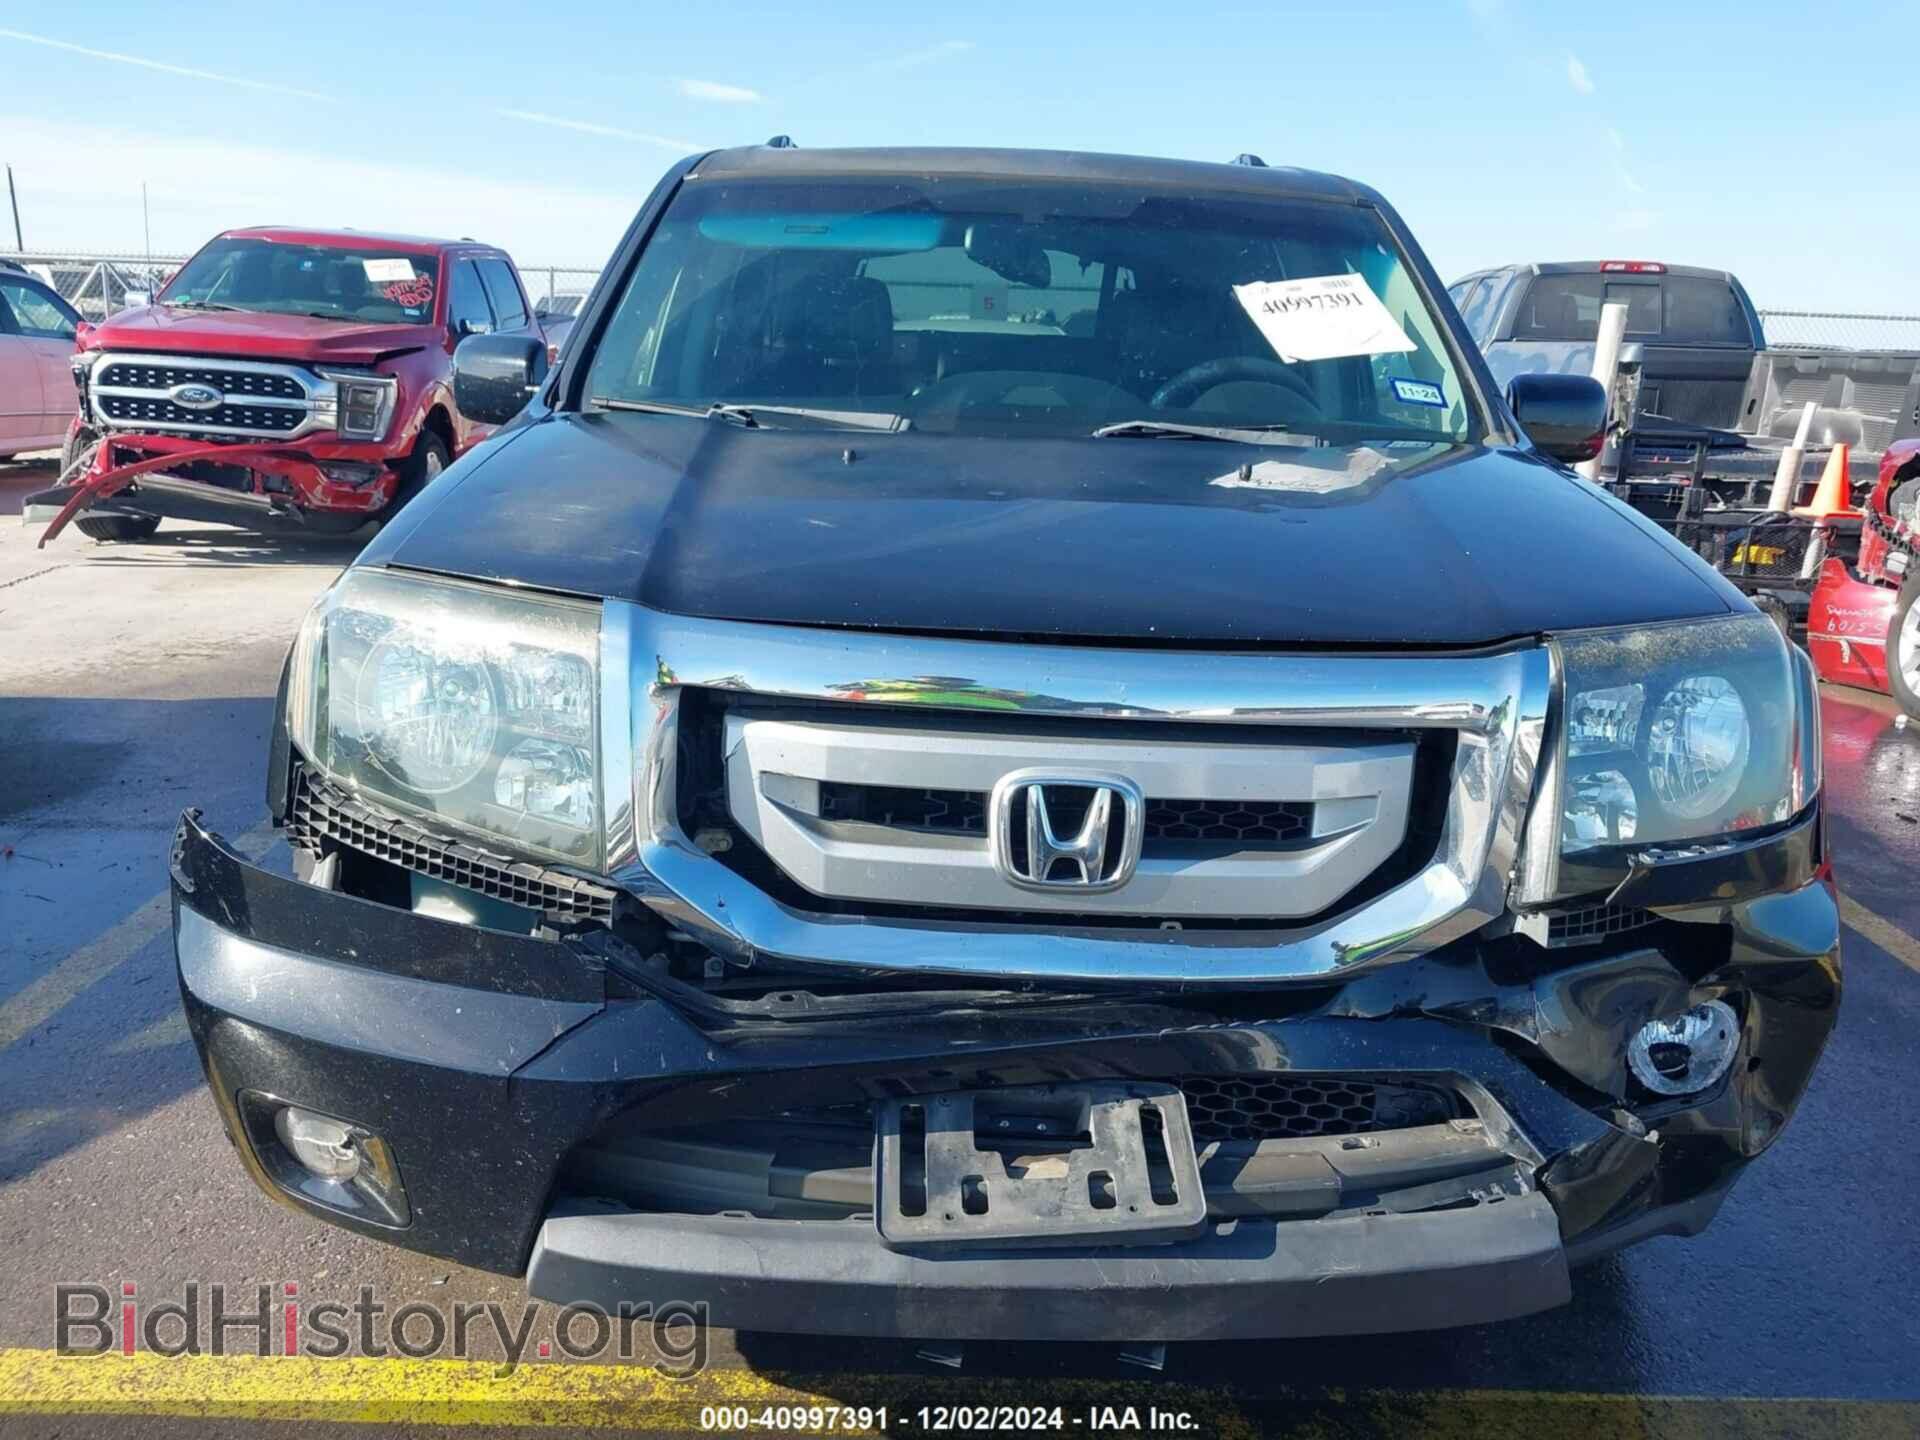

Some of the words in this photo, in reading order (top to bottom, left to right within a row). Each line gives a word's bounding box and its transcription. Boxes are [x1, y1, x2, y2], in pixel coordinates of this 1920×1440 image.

[1263, 292, 1364, 314] 40997391
[181, 388, 214, 402] Ford
[1401, 386, 1438, 399] 11-24
